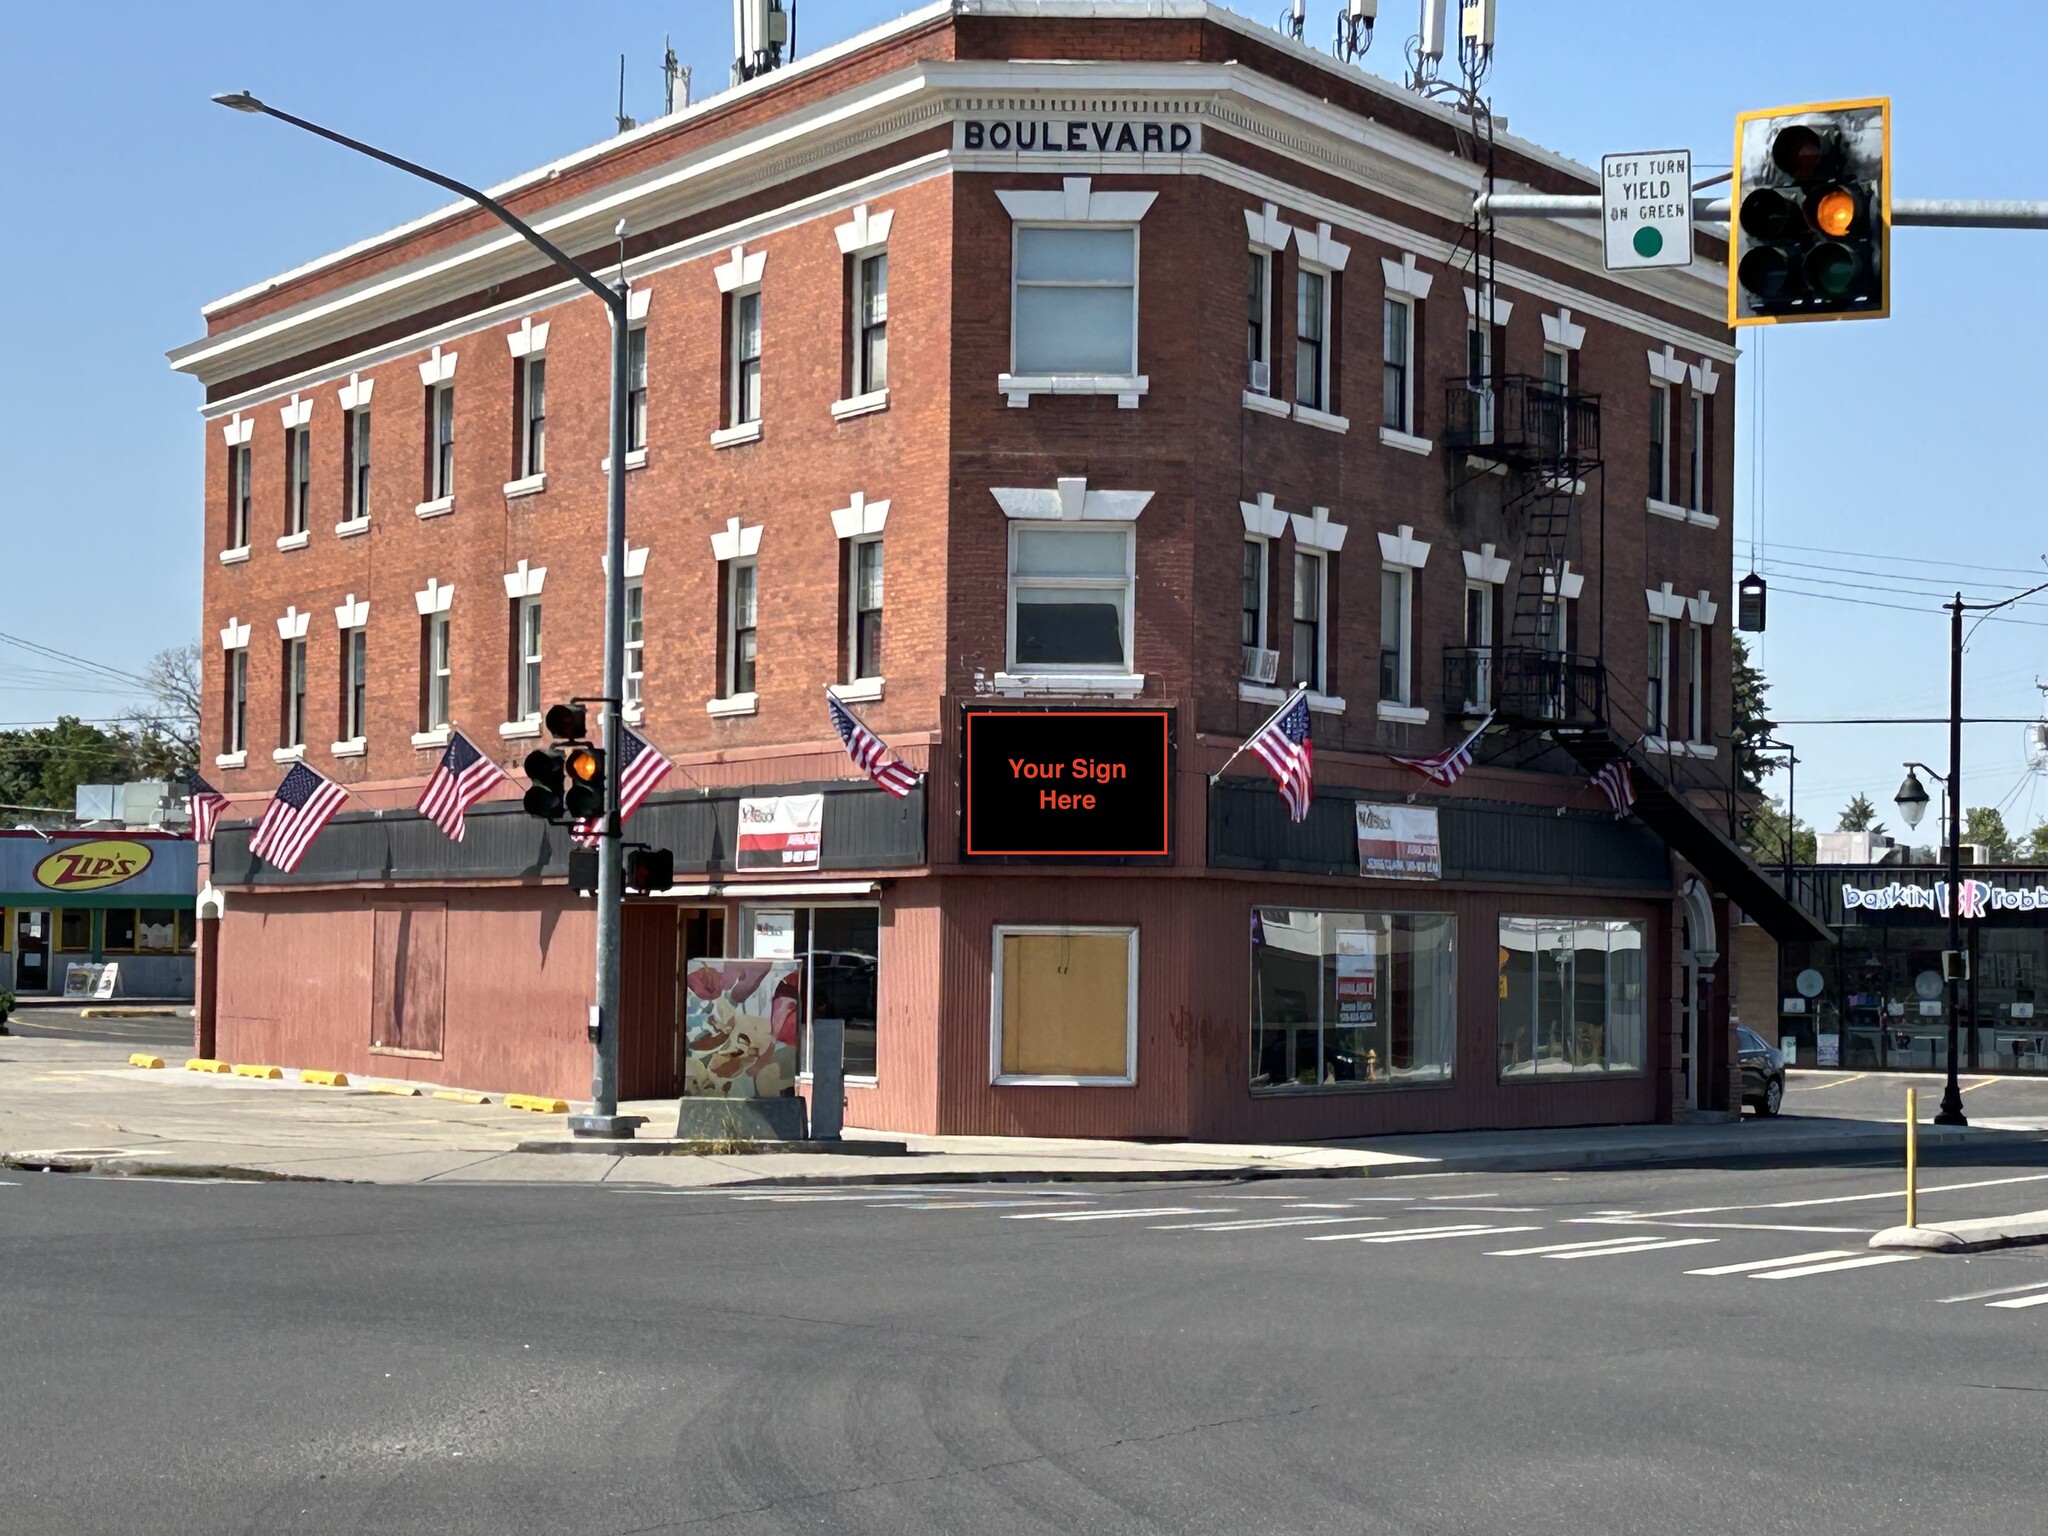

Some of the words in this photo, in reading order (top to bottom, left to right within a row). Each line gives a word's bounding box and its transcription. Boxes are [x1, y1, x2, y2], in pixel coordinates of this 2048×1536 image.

[965, 121, 1192, 151] BOULEVARD
[1607, 162, 1638, 178] LEFT
[1650, 160, 1685, 175] TURN
[1623, 181, 1670, 200] YIELD
[1639, 204, 1684, 220] GREEN
[1842, 882, 1934, 910] baskin
